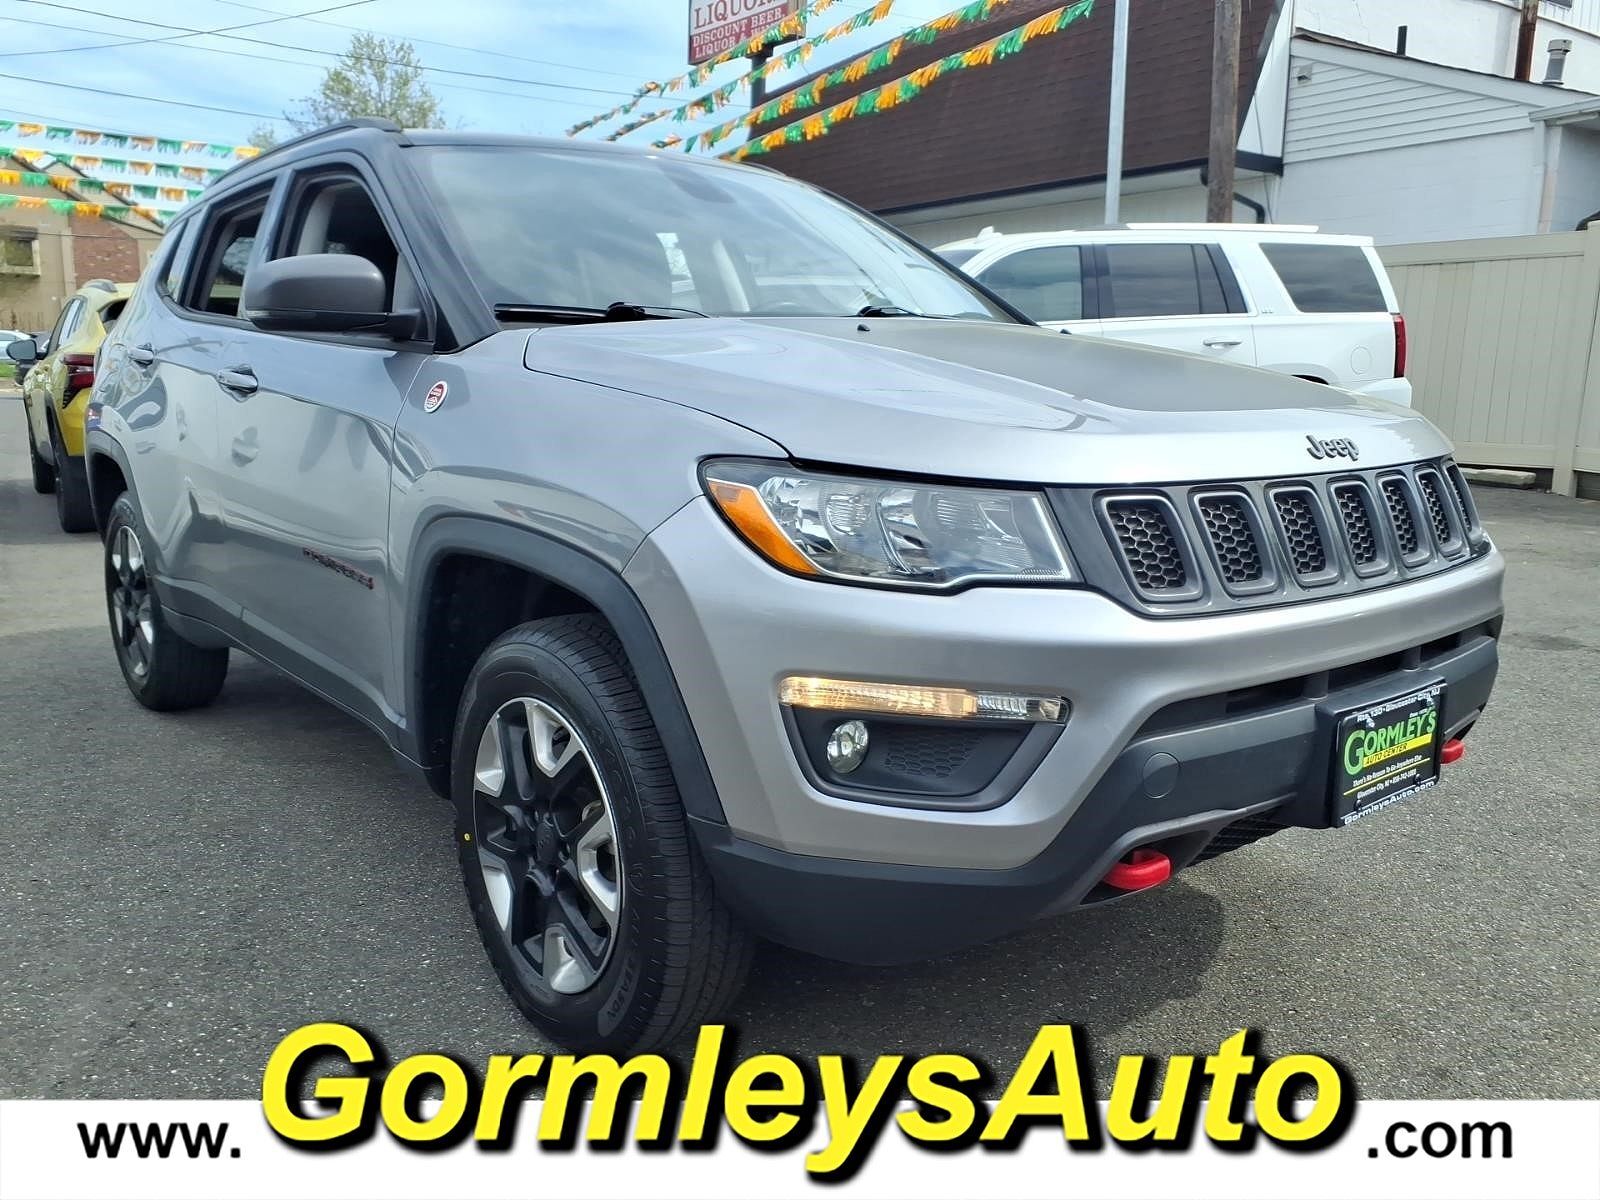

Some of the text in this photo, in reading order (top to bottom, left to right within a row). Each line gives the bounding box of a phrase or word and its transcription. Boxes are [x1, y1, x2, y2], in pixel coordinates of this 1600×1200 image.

[694, 0, 777, 29] LIQUO
[693, 19, 748, 47] DISCOUNT
[695, 36, 736, 58] LIQUOR
[1306, 434, 1360, 462] Jeep
[1344, 711, 1437, 775] GORMLEY'S
[1366, 742, 1408, 765] AUTO CENTER
